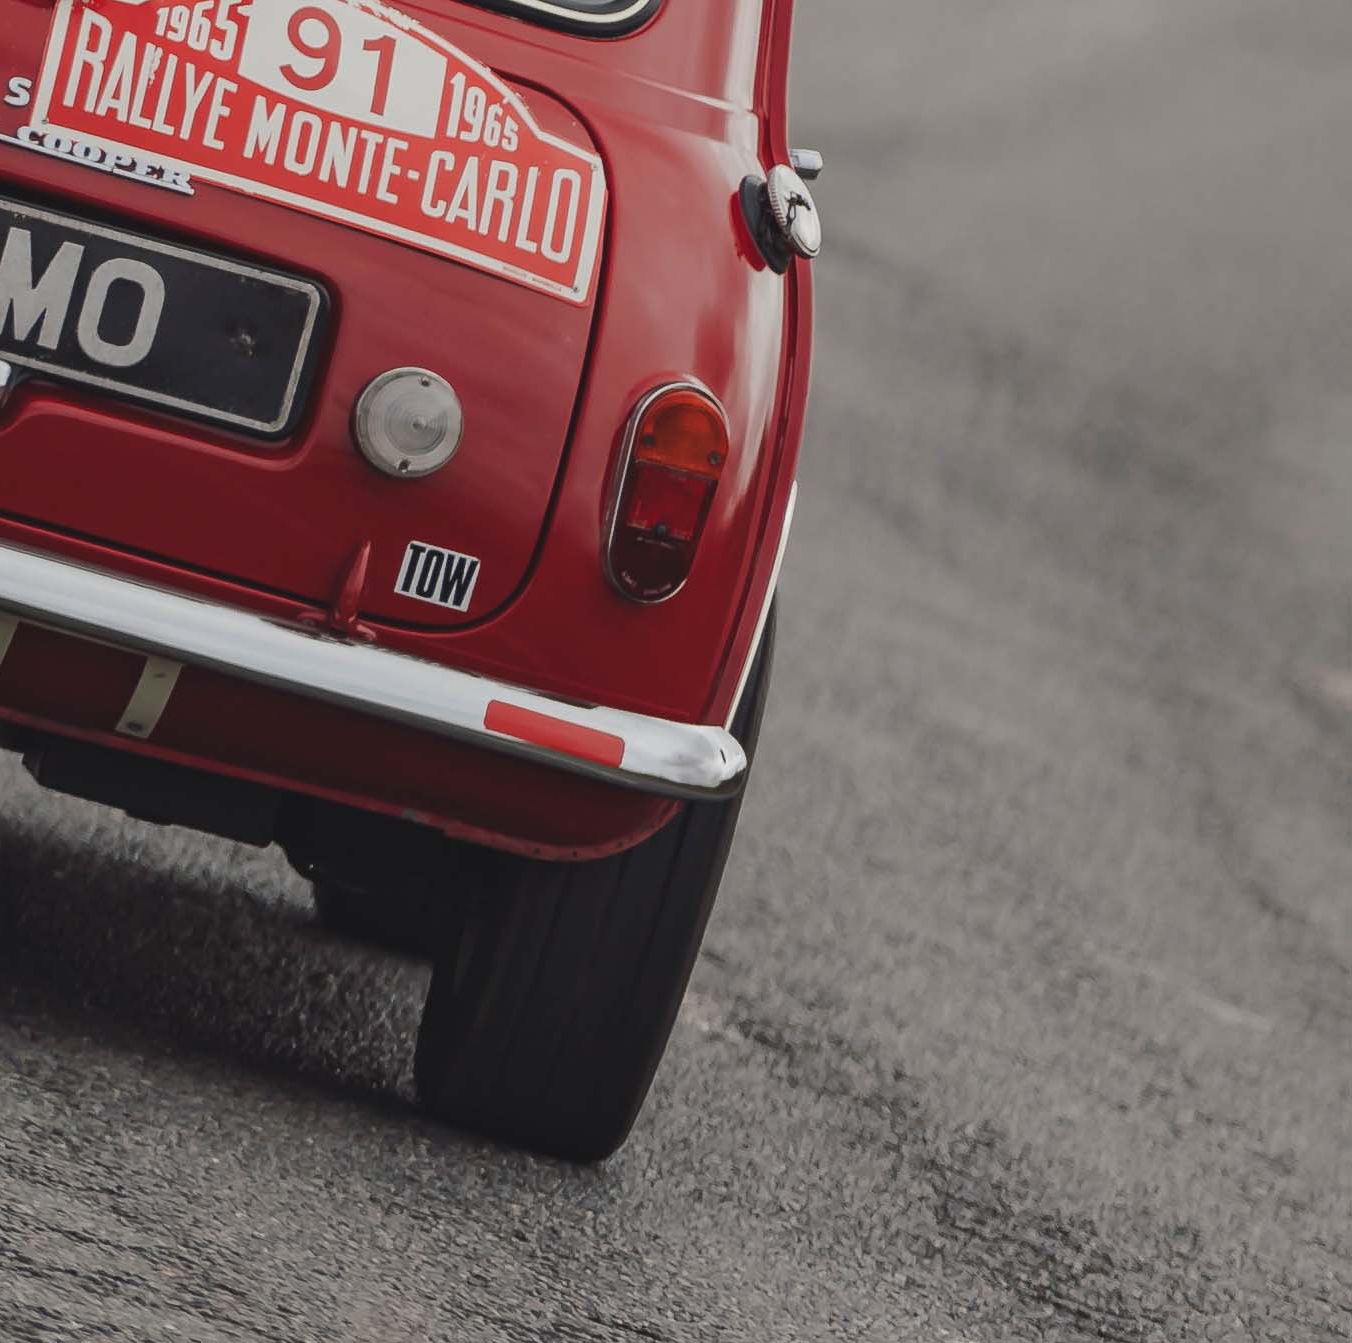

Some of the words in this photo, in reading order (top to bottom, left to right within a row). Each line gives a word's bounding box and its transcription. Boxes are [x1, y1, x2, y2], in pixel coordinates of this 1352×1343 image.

[3, 76, 32, 108] S
[279, 5, 398, 116] 91
[62, 7, 238, 150] RALLYE
[242, 94, 582, 265] MONTE-CARLO
[444, 72, 519, 153] 1965
[16, 125, 193, 194] COOPER
[400, 542, 479, 607] TOW
